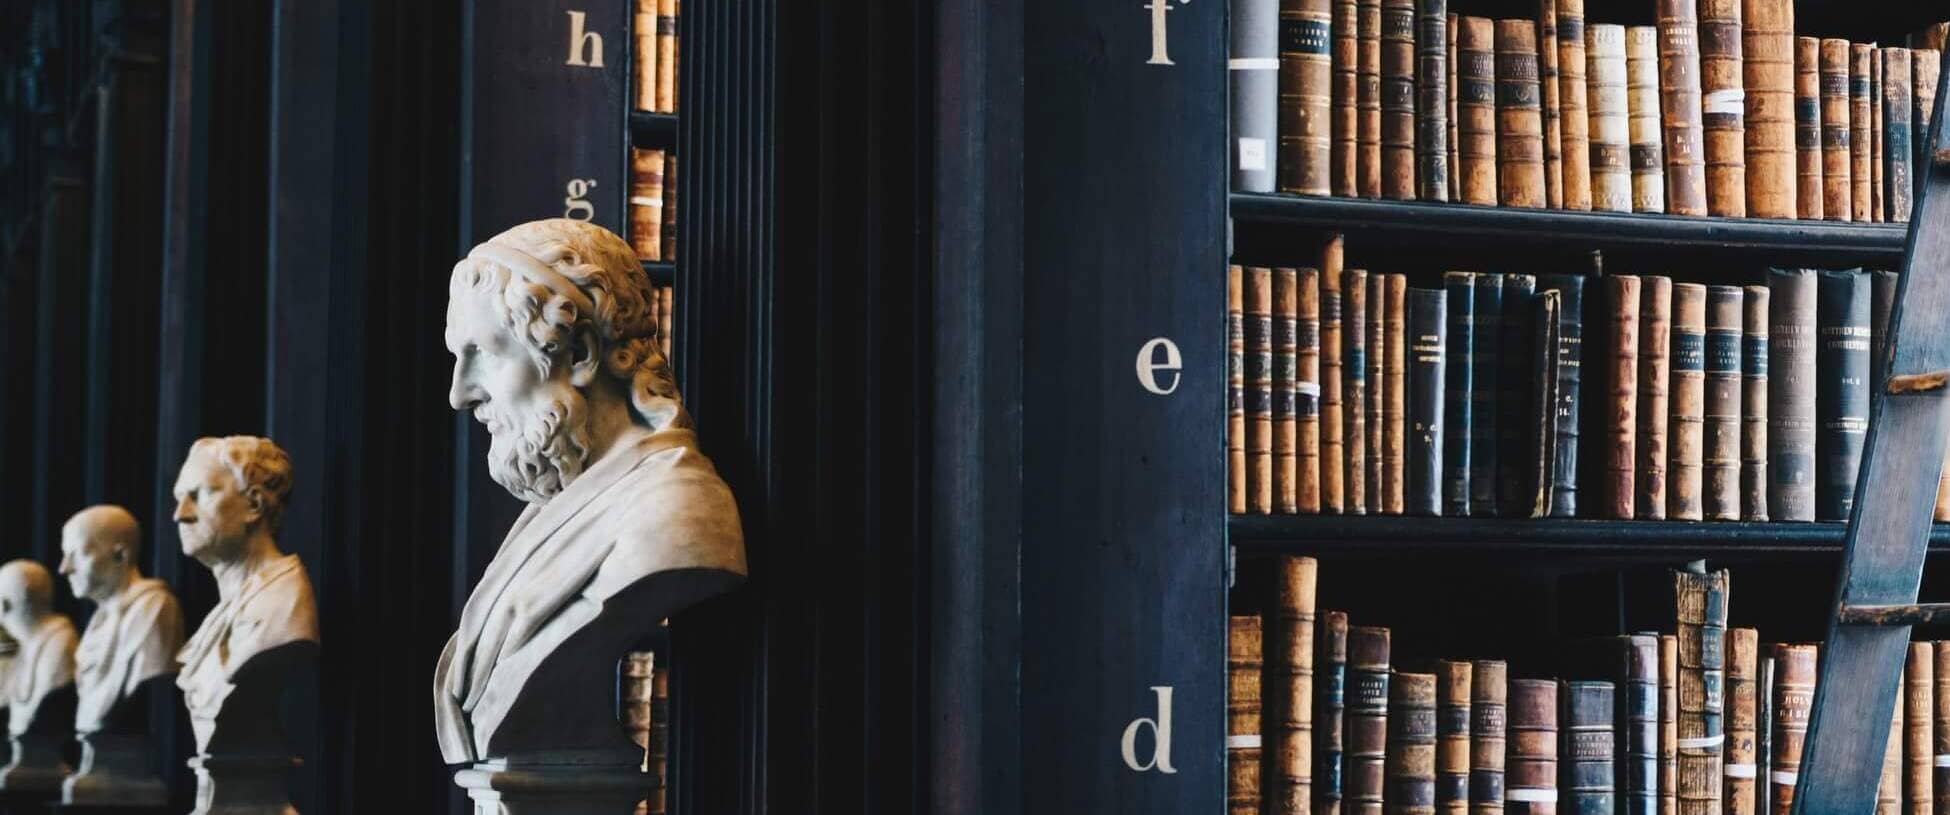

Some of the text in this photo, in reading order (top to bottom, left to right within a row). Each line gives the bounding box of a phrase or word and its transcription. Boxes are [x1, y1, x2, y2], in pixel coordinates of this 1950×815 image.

[565, 10, 604, 68] h
[1144, 0, 1191, 65] f
[564, 178, 597, 222] g
[1136, 337, 1182, 395] e
[1121, 686, 1177, 773] d
